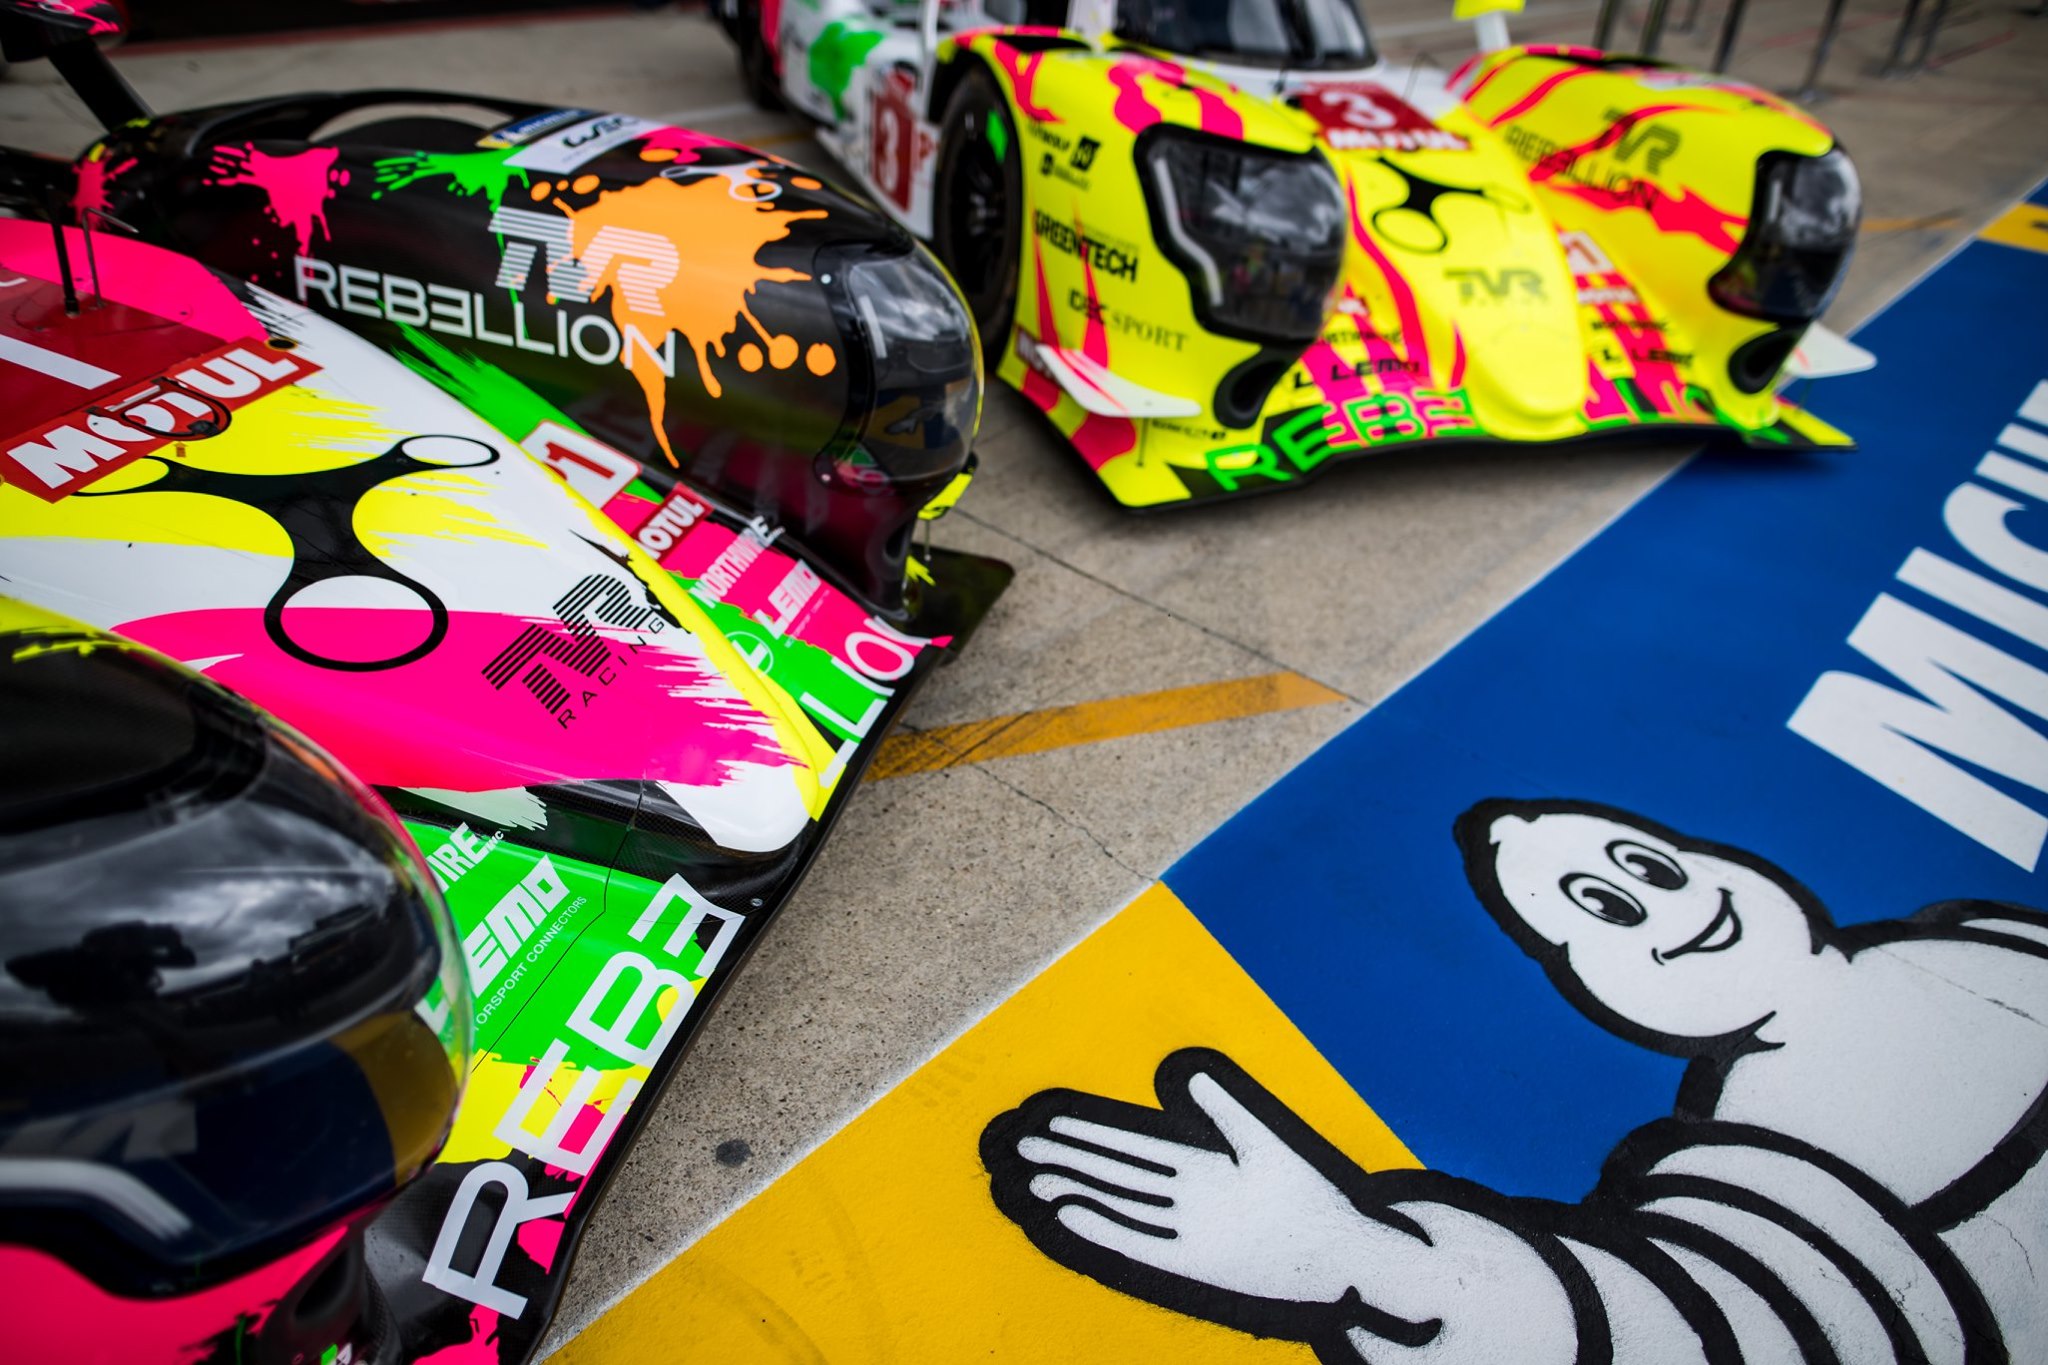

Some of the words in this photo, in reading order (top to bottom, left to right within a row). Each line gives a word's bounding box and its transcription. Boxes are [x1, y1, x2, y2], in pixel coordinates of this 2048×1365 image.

[1321, 91, 1399, 128] 3
[294, 253, 678, 380] REBELLION
[6, 347, 300, 490] MOTUL
[556, 616, 665, 730] RACING
[525, 895, 588, 964] CONNECTORS
